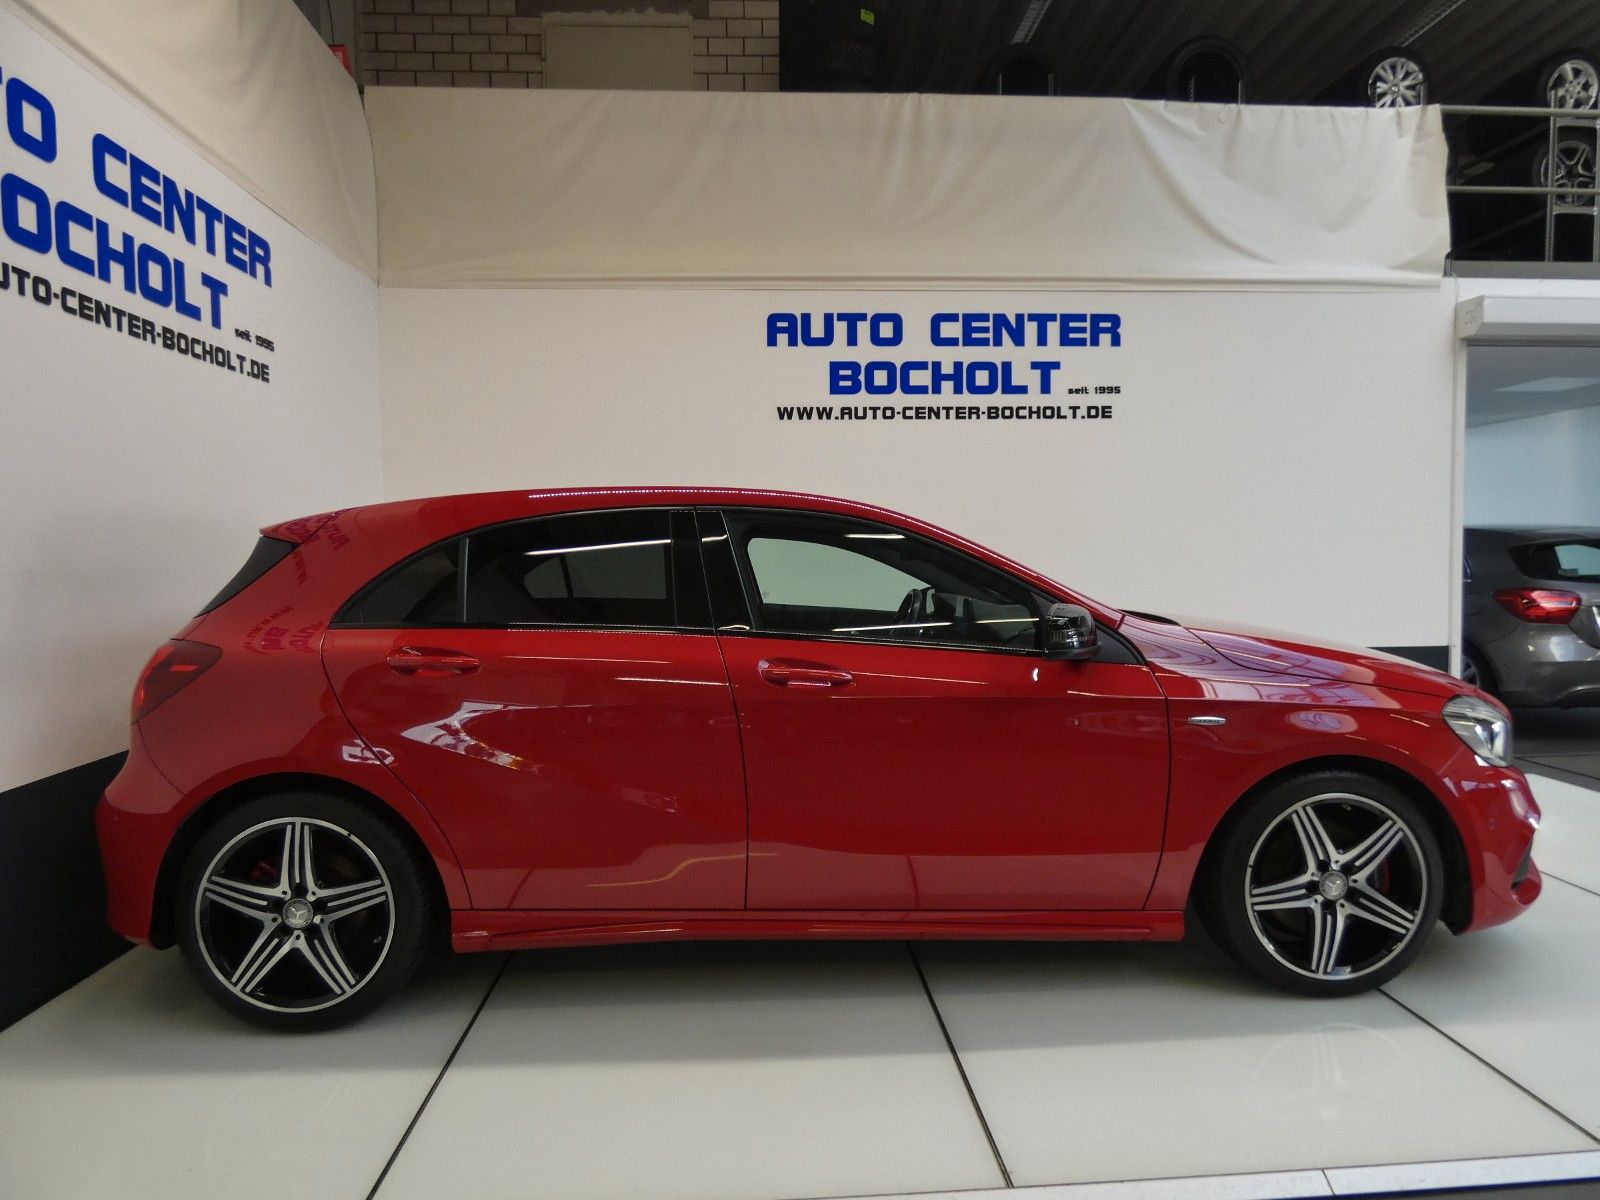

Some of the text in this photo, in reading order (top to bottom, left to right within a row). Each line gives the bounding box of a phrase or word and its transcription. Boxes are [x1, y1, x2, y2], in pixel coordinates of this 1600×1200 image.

[92, 133, 272, 288] CENTER
[255, 334, 275, 352] 1995
[766, 313, 1121, 347] AUTO CENTER
[829, 361, 1121, 395] BOCHOLT seit 1995
[777, 405, 1112, 420] WWW.AUTO-CENTER-BOCHOLT.DE
